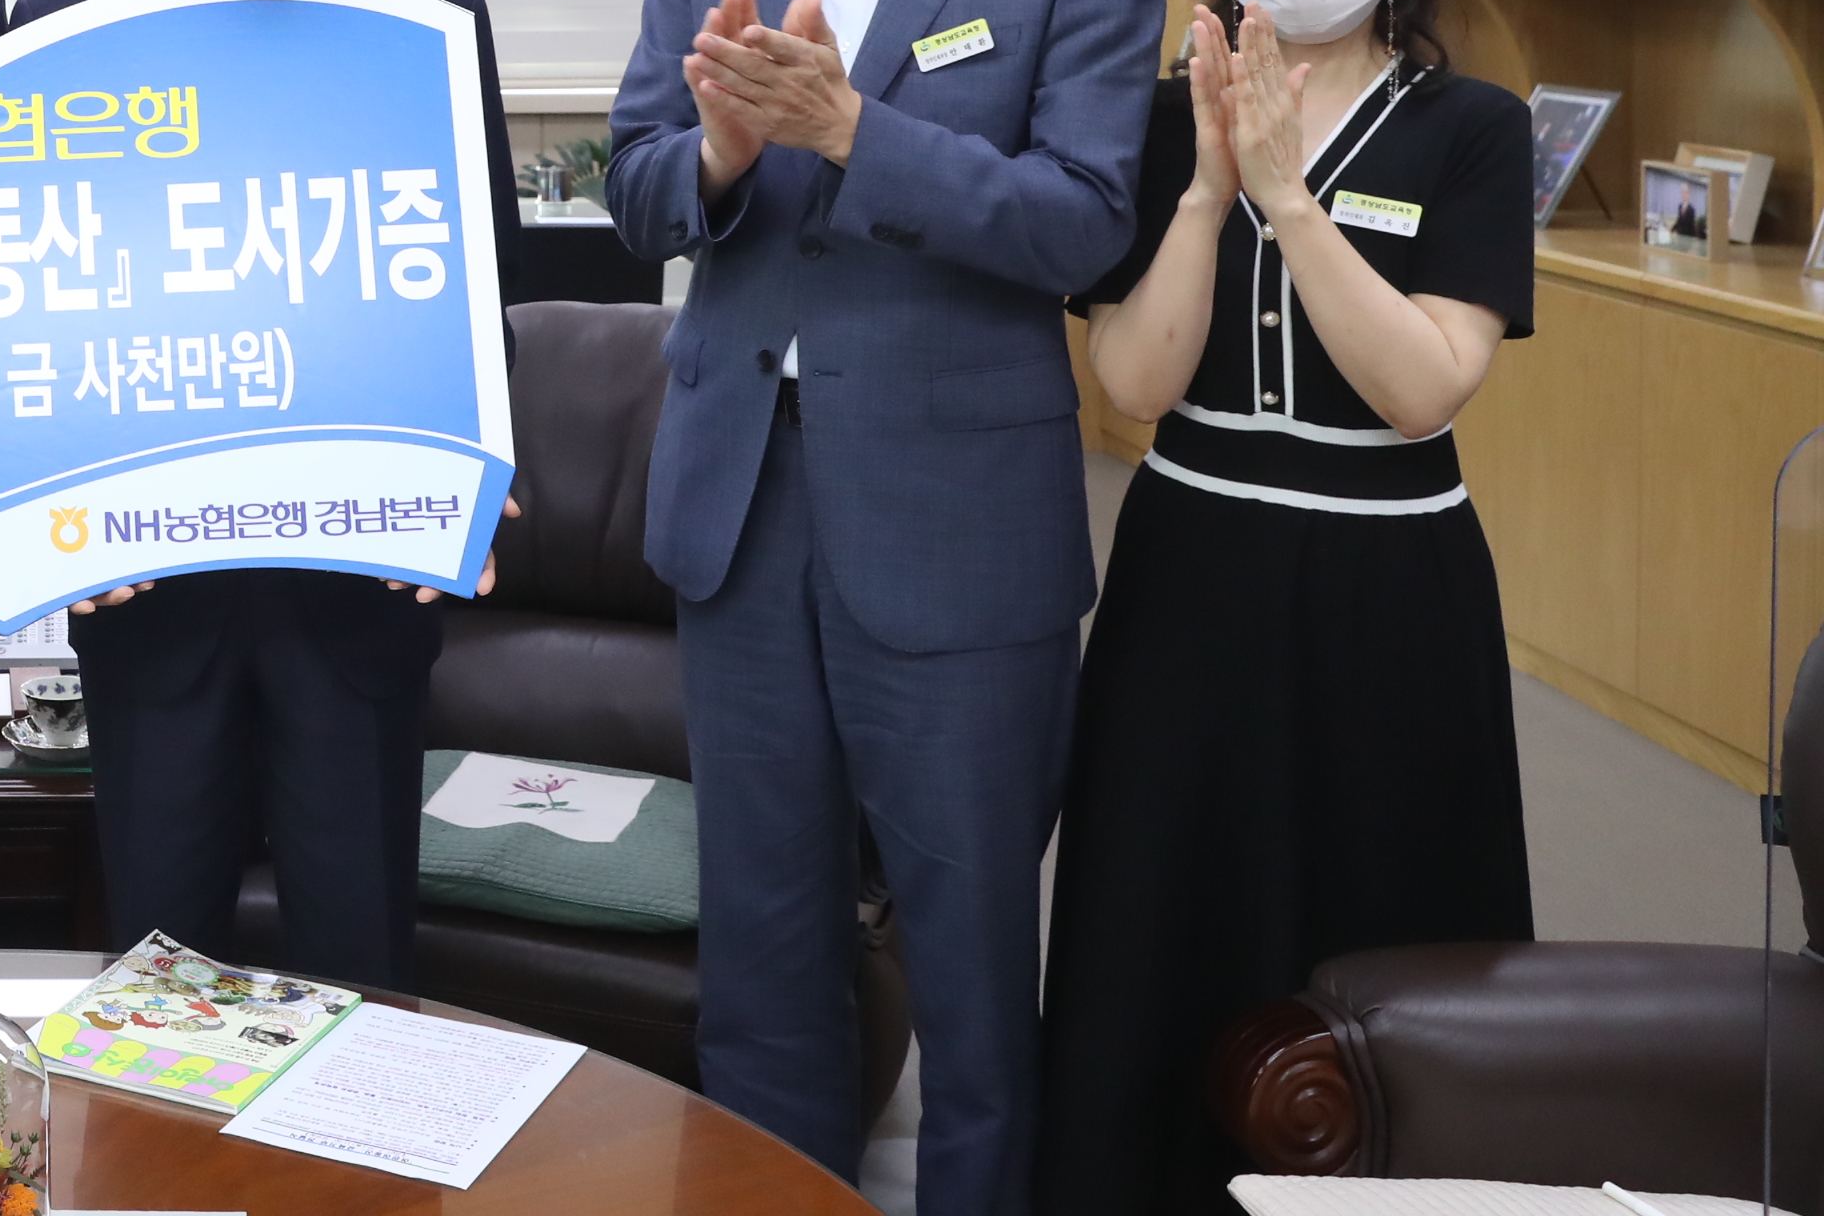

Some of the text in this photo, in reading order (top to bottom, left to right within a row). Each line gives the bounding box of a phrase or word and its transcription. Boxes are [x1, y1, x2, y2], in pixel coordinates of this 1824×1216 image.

[162, 168, 450, 305] 도서기증
[6, 342, 58, 418] 금
[73, 327, 295, 415] 사천만원)
[104, 494, 462, 544] NH농협은행 경남본부
[93, 1049, 234, 1091] 어린이동산
